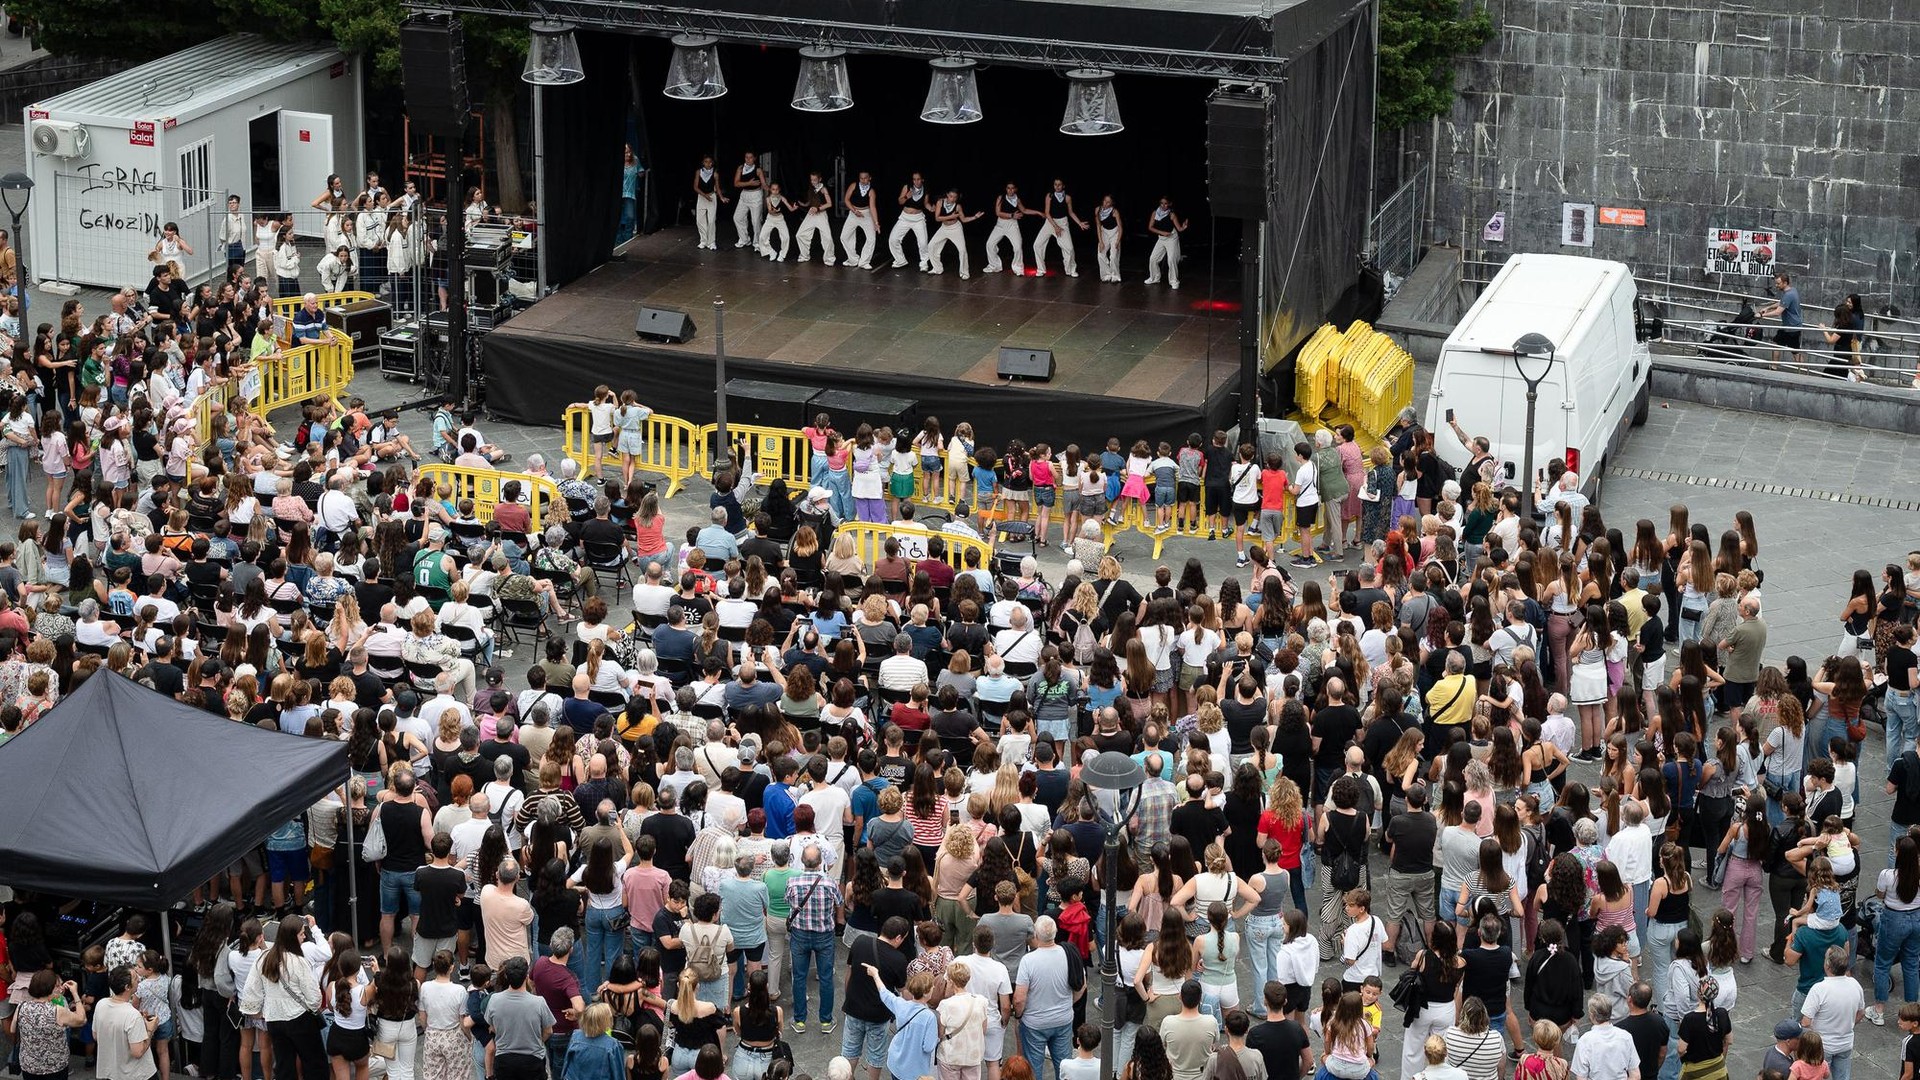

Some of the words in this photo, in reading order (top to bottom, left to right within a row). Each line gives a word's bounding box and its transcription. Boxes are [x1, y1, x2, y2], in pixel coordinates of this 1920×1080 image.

[130, 131, 154, 142] balat
[77, 163, 163, 195] ISRAEL
[1714, 260, 1741, 273] BULTZA
[1748, 263, 1775, 275] BULTZA
[419, 568, 430, 586] 0
[114, 600, 127, 614] 10
